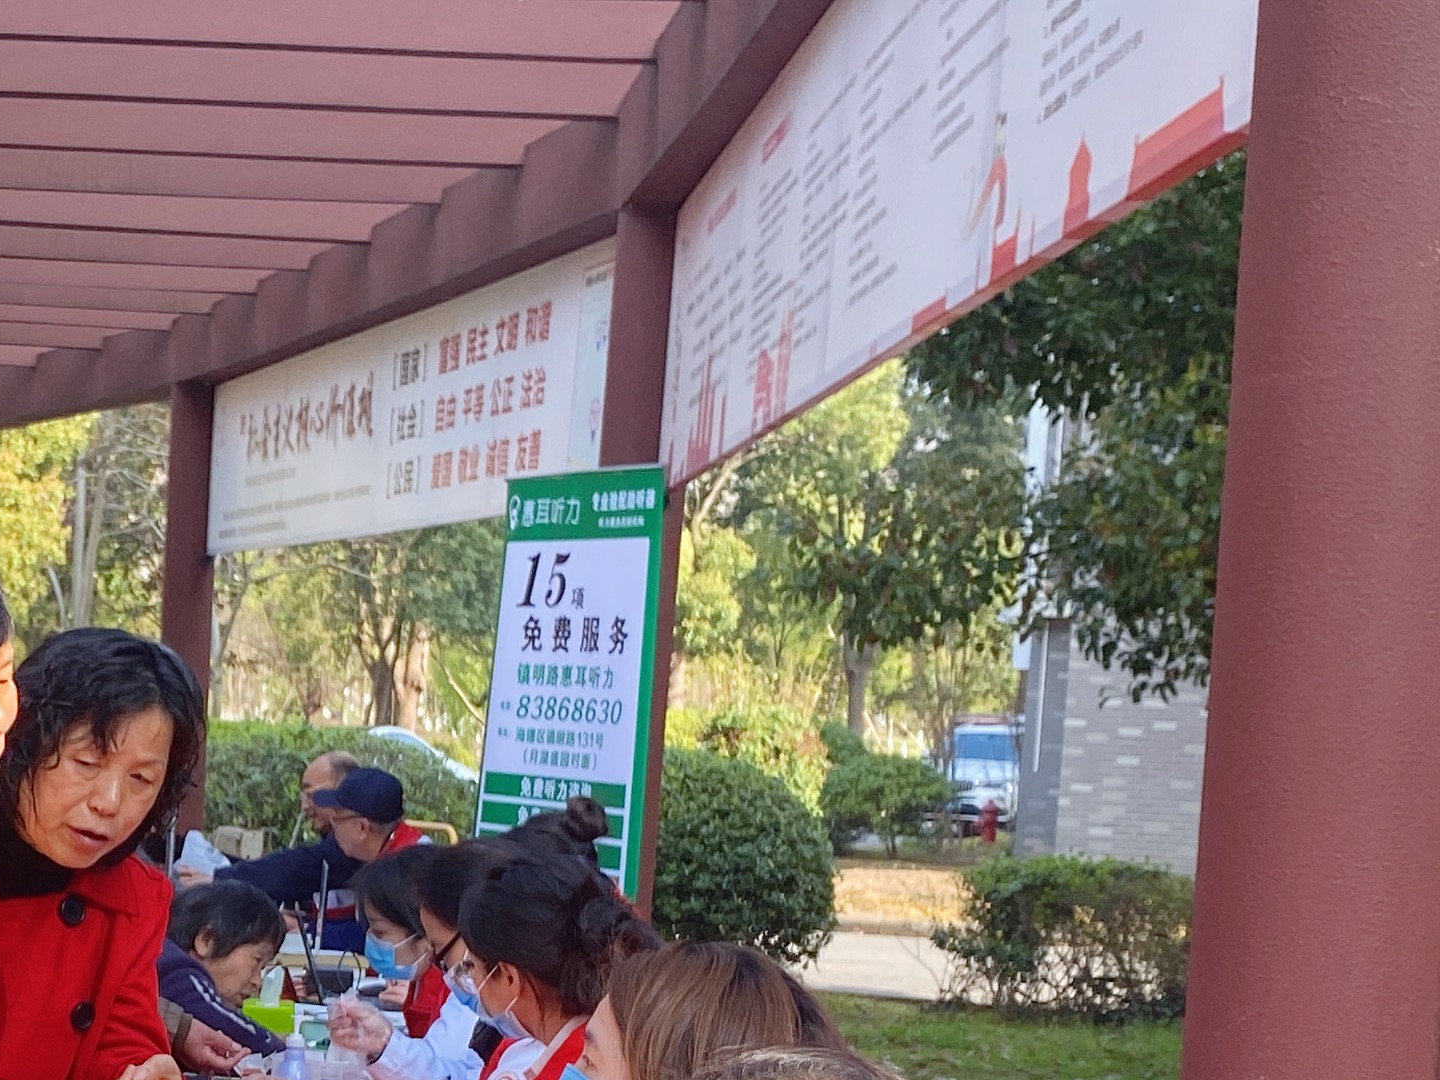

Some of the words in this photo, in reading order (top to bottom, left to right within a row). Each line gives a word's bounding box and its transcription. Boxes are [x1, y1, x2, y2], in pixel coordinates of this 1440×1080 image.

[465, 322, 488, 366] 民主
[494, 312, 520, 356] 文明
[434, 391, 456, 433] 自由
[462, 383, 485, 425] 平等
[490, 376, 515, 416] 公正
[519, 366, 546, 410] 法治
[515, 429, 541, 472] 友善
[522, 494, 581, 527] 惠耳听力
[521, 615, 628, 655] 免费服务
[517, 661, 614, 690] 镇明路惠耳听力
[516, 694, 623, 725] 83868630
